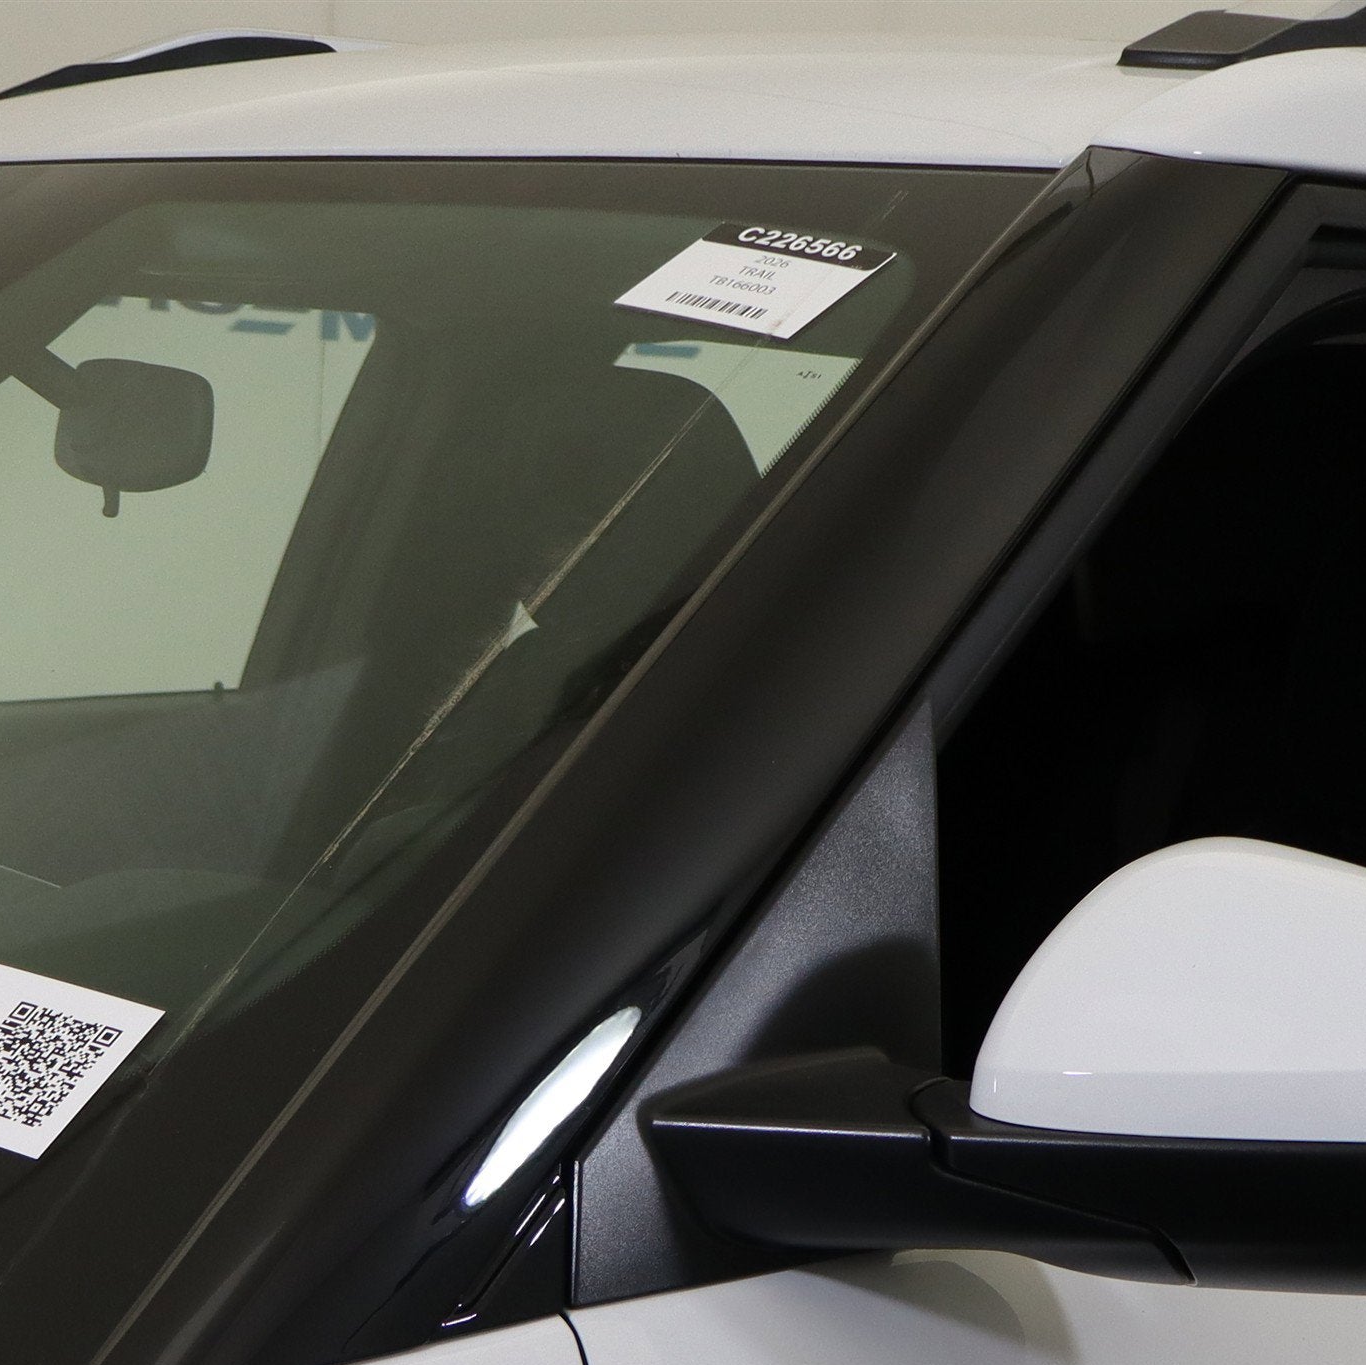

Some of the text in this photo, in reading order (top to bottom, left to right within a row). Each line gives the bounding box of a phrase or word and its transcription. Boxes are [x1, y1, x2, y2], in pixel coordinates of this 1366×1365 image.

[737, 226, 863, 261] C226566
[754, 255, 792, 269] 2026
[738, 265, 777, 281] TRAIL
[709, 274, 777, 296] TB166003
